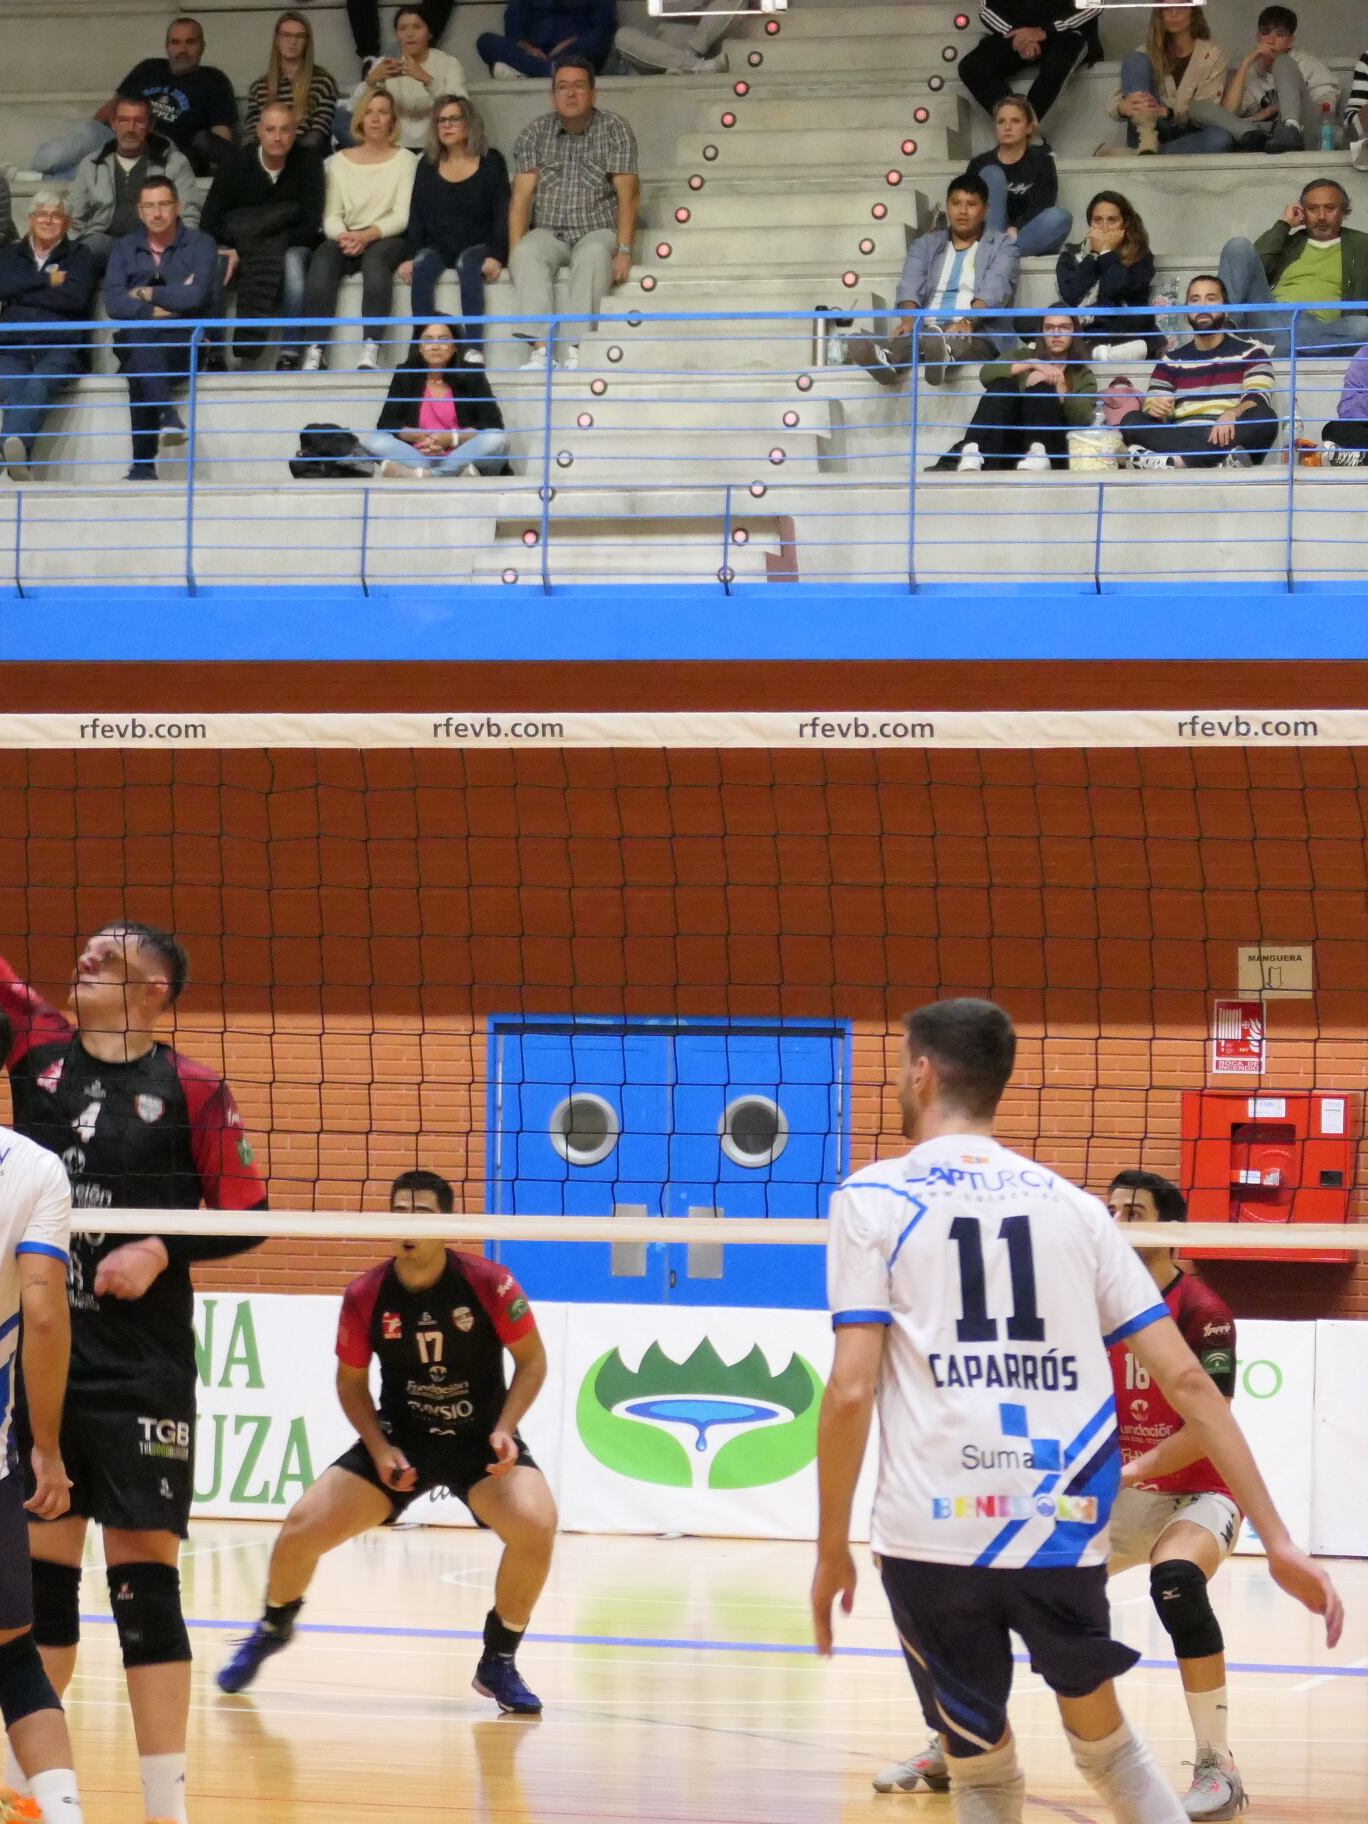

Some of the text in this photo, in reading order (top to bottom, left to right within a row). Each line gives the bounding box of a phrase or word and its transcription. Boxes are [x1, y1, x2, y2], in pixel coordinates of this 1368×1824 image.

[79, 717, 207, 739] rfevb.com
[432, 717, 565, 739] rfevb.com
[798, 717, 935, 739] rfevb.com
[1177, 716, 1318, 737] rfevb.com
[1247, 954, 1303, 962] MANGUERA
[947, 1214, 1046, 1343] 11
[415, 1331, 444, 1364] 17
[928, 1348, 1079, 1392] CAPARRÓS
[137, 1415, 190, 1448] TGB
[961, 1444, 1034, 1470] Suma
